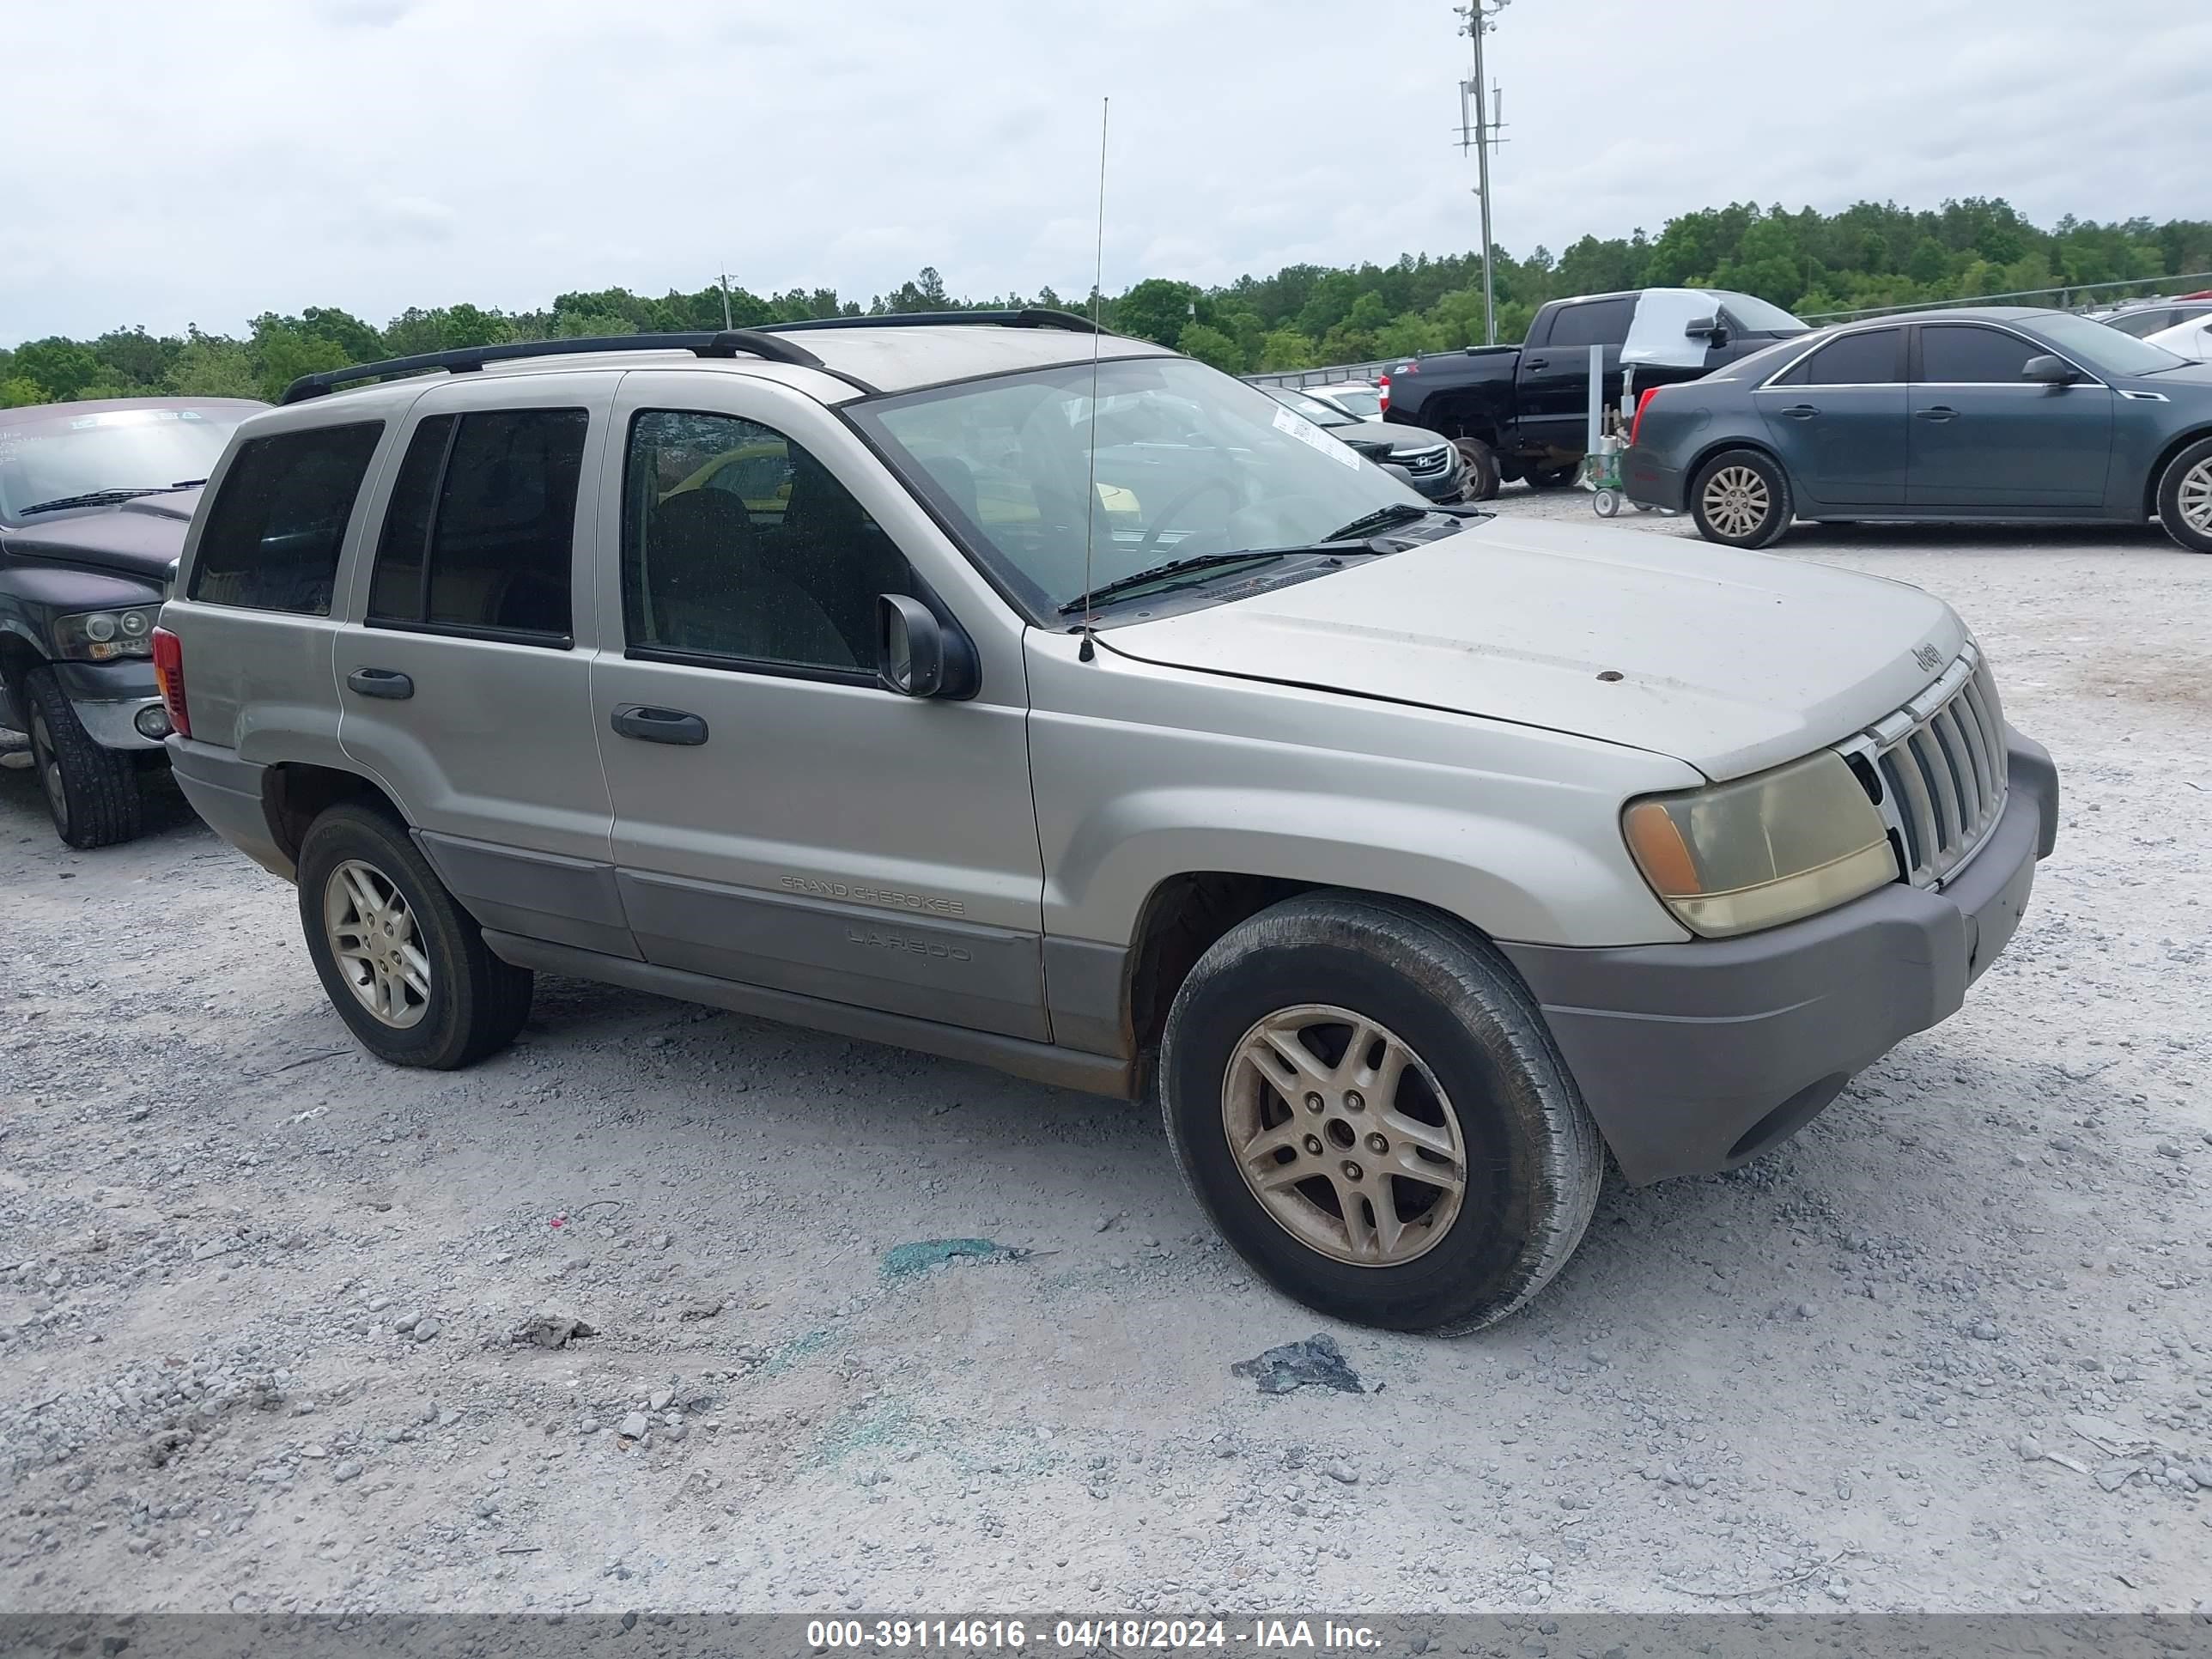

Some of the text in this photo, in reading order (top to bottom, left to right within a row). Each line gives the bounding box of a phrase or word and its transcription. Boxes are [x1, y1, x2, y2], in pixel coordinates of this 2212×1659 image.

[781, 875, 965, 915] GRAND CHEROKEE
[847, 927, 972, 962] LAREDO
